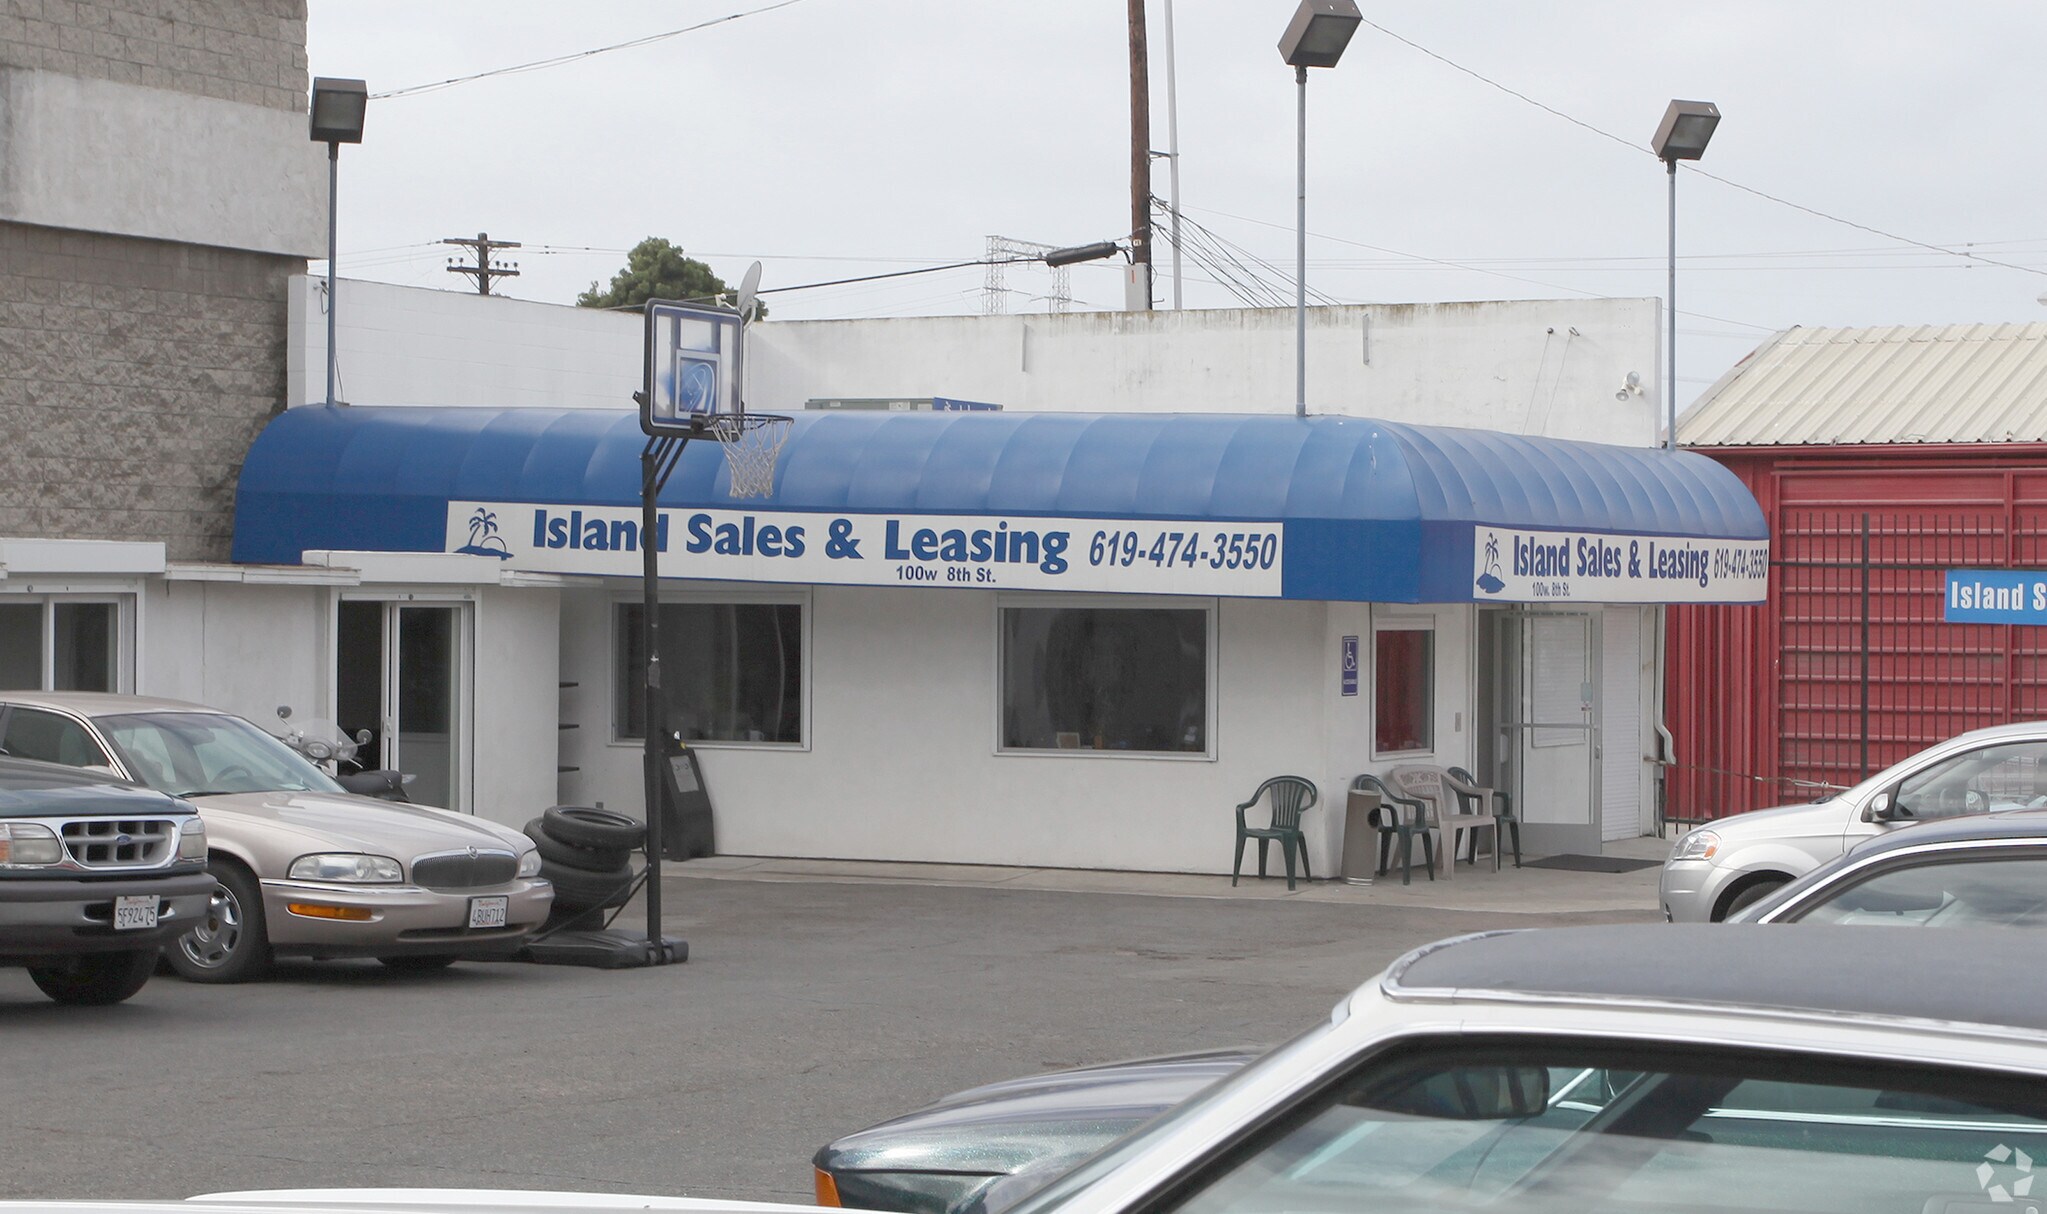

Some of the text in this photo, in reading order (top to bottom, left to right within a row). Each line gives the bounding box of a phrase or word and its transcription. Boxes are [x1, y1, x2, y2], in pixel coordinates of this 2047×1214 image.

[533, 509, 1278, 576] Island Sales & Leasing 619-474-3550
[896, 565, 997, 583] 100w 8th St.
[1513, 535, 1768, 588] Island Sales & Leasing 619-474-3550
[1552, 582, 1561, 596] 8th
[1562, 582, 1570, 596] St.
[1951, 581, 2024, 611] Island
